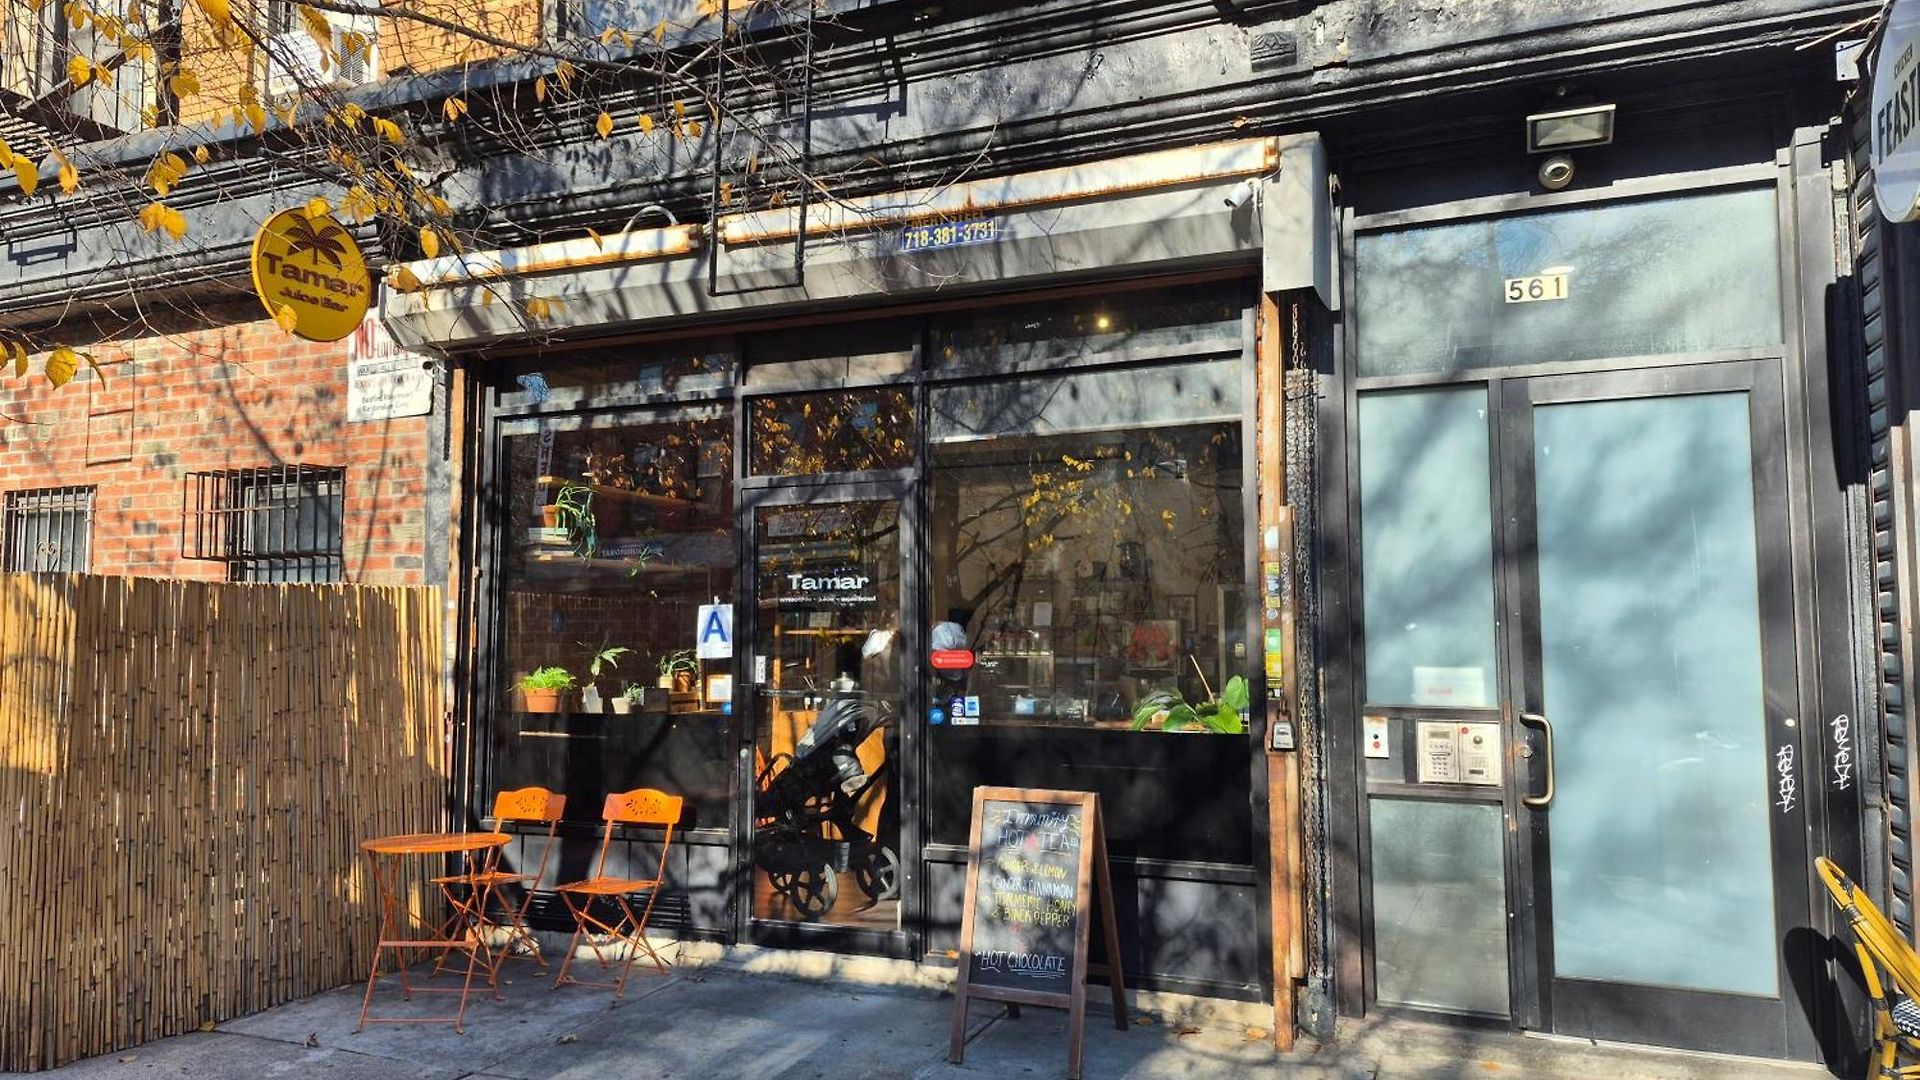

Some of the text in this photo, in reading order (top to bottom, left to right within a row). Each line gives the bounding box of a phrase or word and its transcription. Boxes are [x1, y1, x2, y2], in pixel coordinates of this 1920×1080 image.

[262, 251, 365, 297] Tamar
[1509, 277, 1560, 300] 561
[787, 574, 870, 590] Tamar
[703, 611, 728, 643] A
